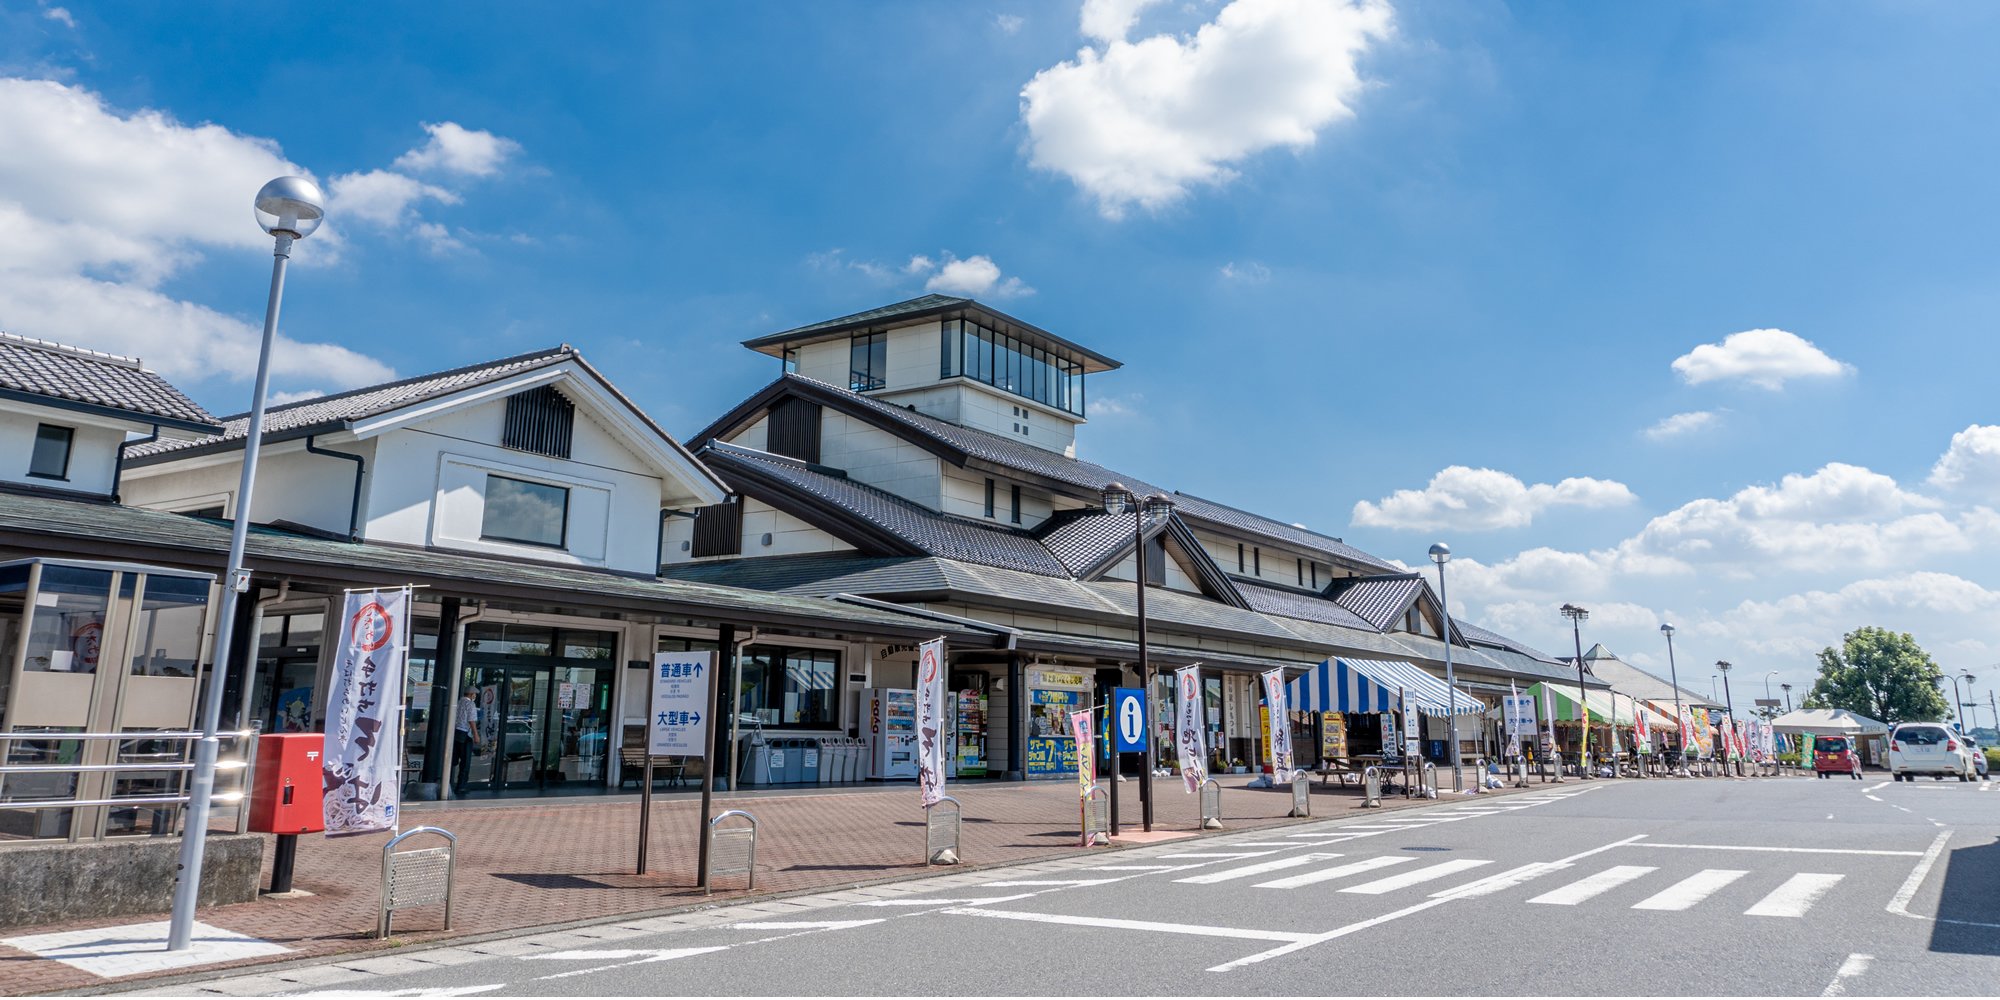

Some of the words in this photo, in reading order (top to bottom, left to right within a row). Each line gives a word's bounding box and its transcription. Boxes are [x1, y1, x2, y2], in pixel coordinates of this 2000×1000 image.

[660, 662, 692, 678] 普通車
[657, 711, 689, 726] 大型車
[872, 699, 881, 734] DyDo
